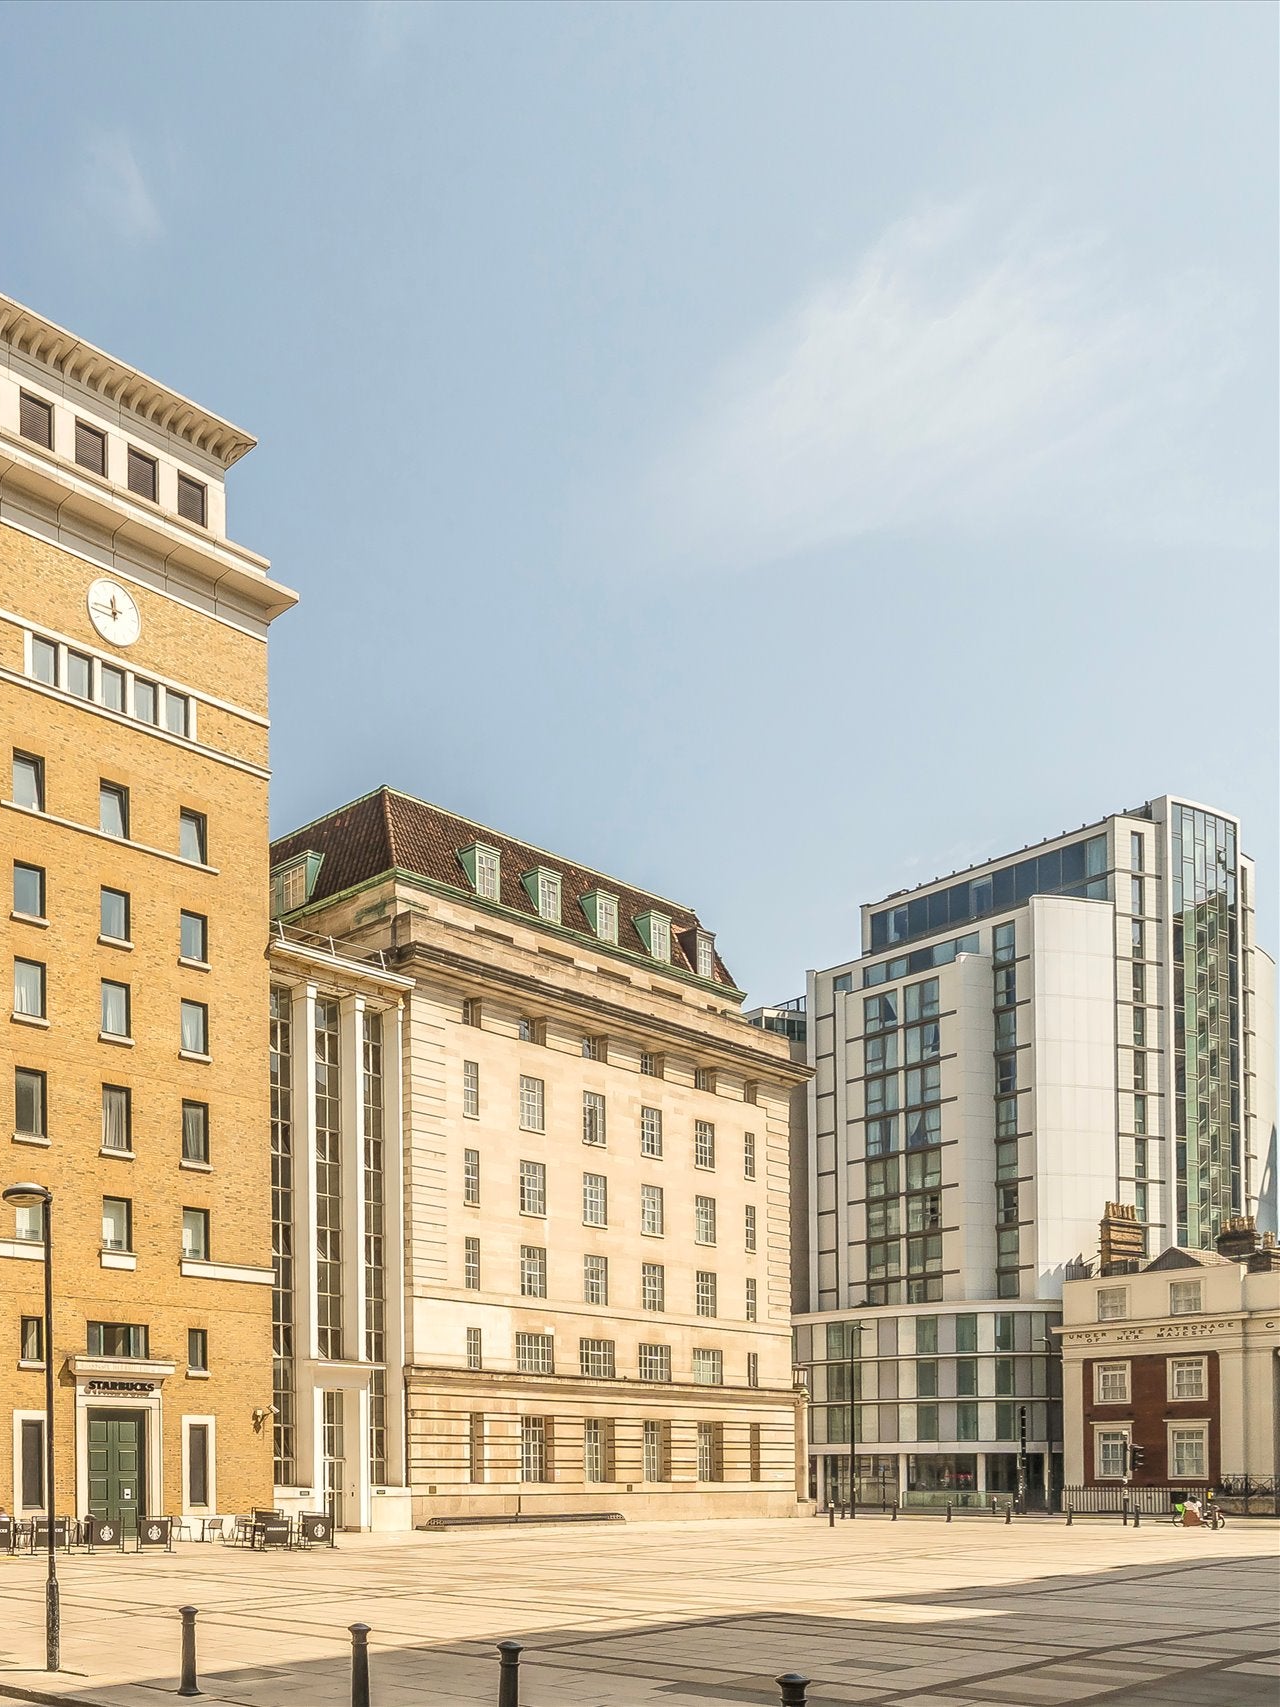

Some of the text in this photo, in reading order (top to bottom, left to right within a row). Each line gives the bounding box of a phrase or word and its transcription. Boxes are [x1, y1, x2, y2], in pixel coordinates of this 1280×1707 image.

[1156, 1328, 1215, 1338] MAJESTY
[1159, 1322, 1234, 1333] PATRONAGE
[88, 1380, 155, 1392] STARBUCKS
